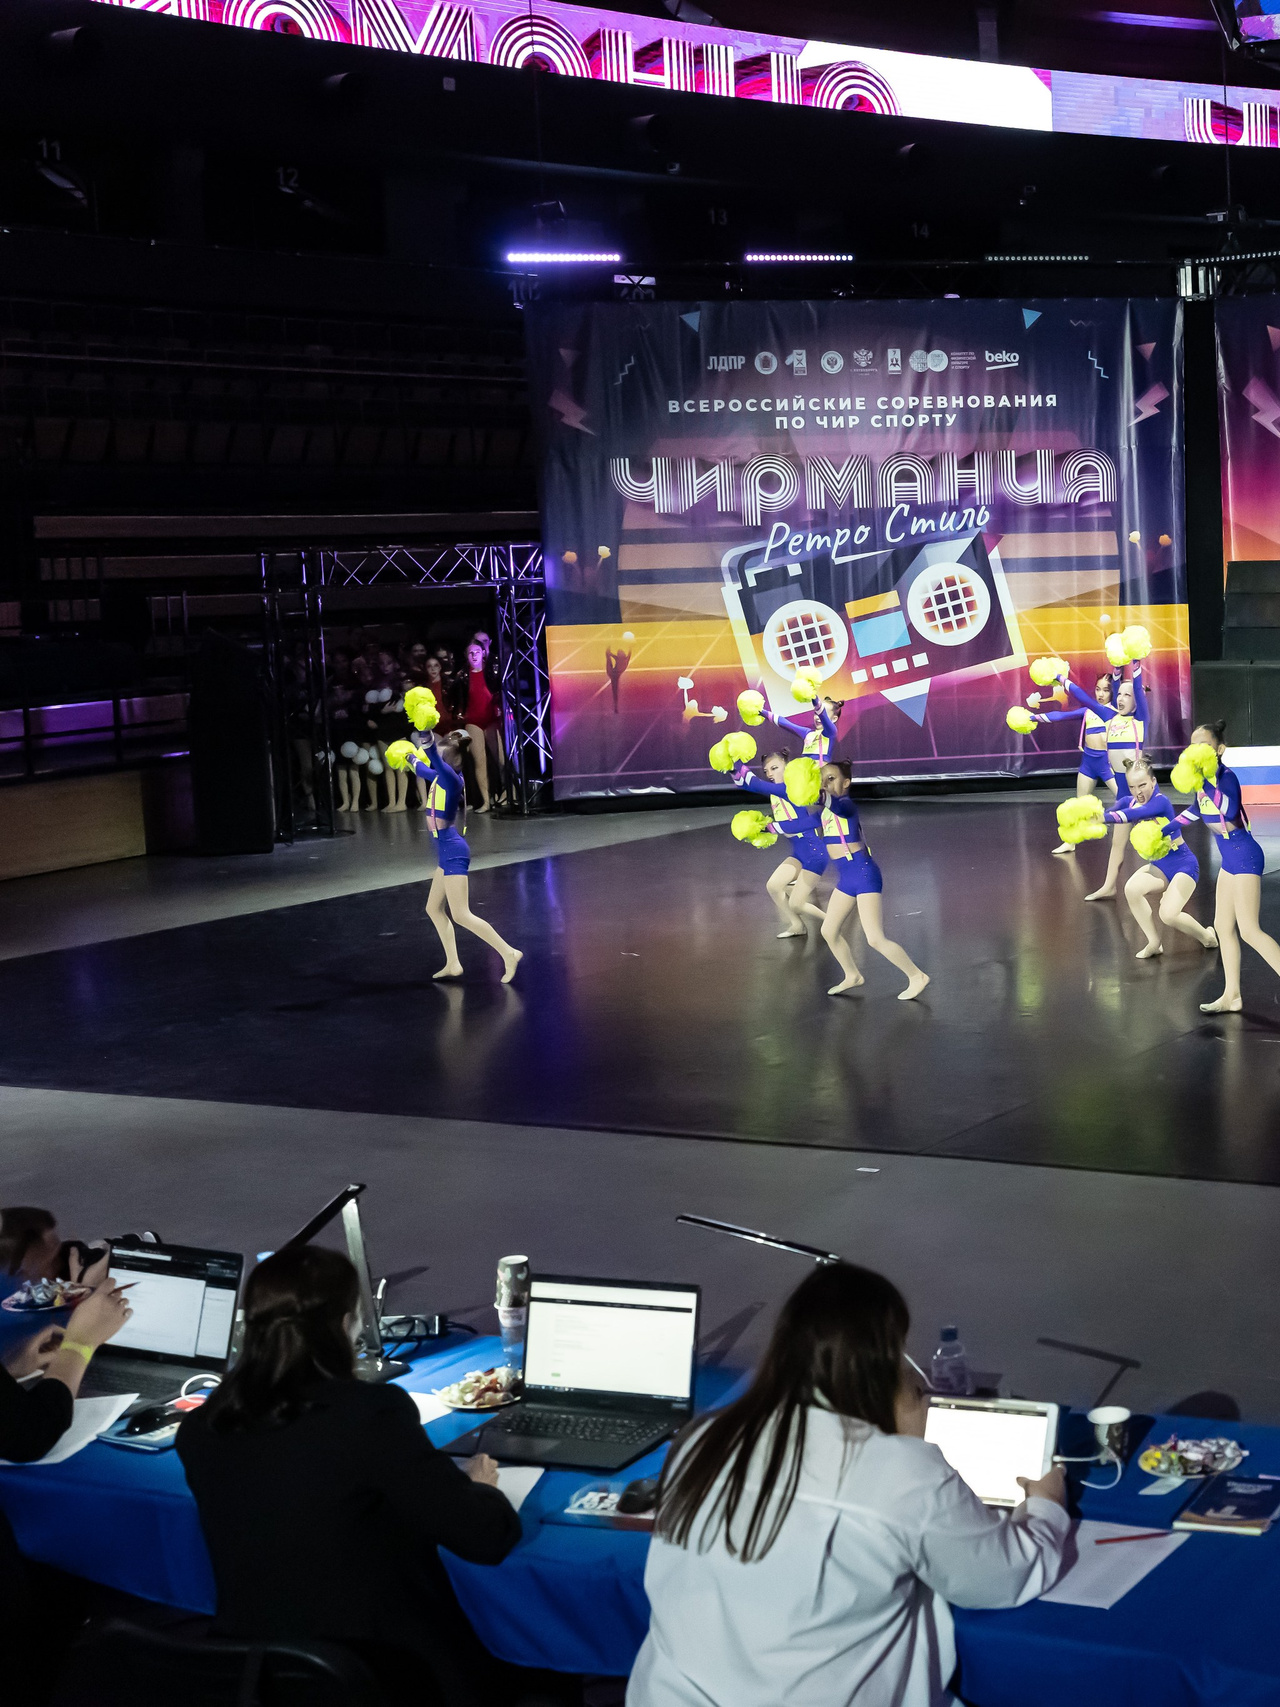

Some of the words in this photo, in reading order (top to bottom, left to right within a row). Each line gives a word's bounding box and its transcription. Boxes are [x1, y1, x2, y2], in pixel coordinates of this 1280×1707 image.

[37, 138, 62, 161] 11
[276, 166, 299, 188] 12
[707, 355, 746, 372] ЛДПР
[985, 350, 1020, 364] beko
[668, 395, 867, 413] ВСЕРОССИЙСКИЕ
[876, 394, 1058, 410] СОРЕВНОВАНИЯ
[775, 415, 806, 430] ПО
[815, 415, 860, 430] ЧИР
[870, 413, 958, 429] СПОРТУ
[763, 521, 872, 565] Ретро
[885, 503, 991, 544] Стиль
